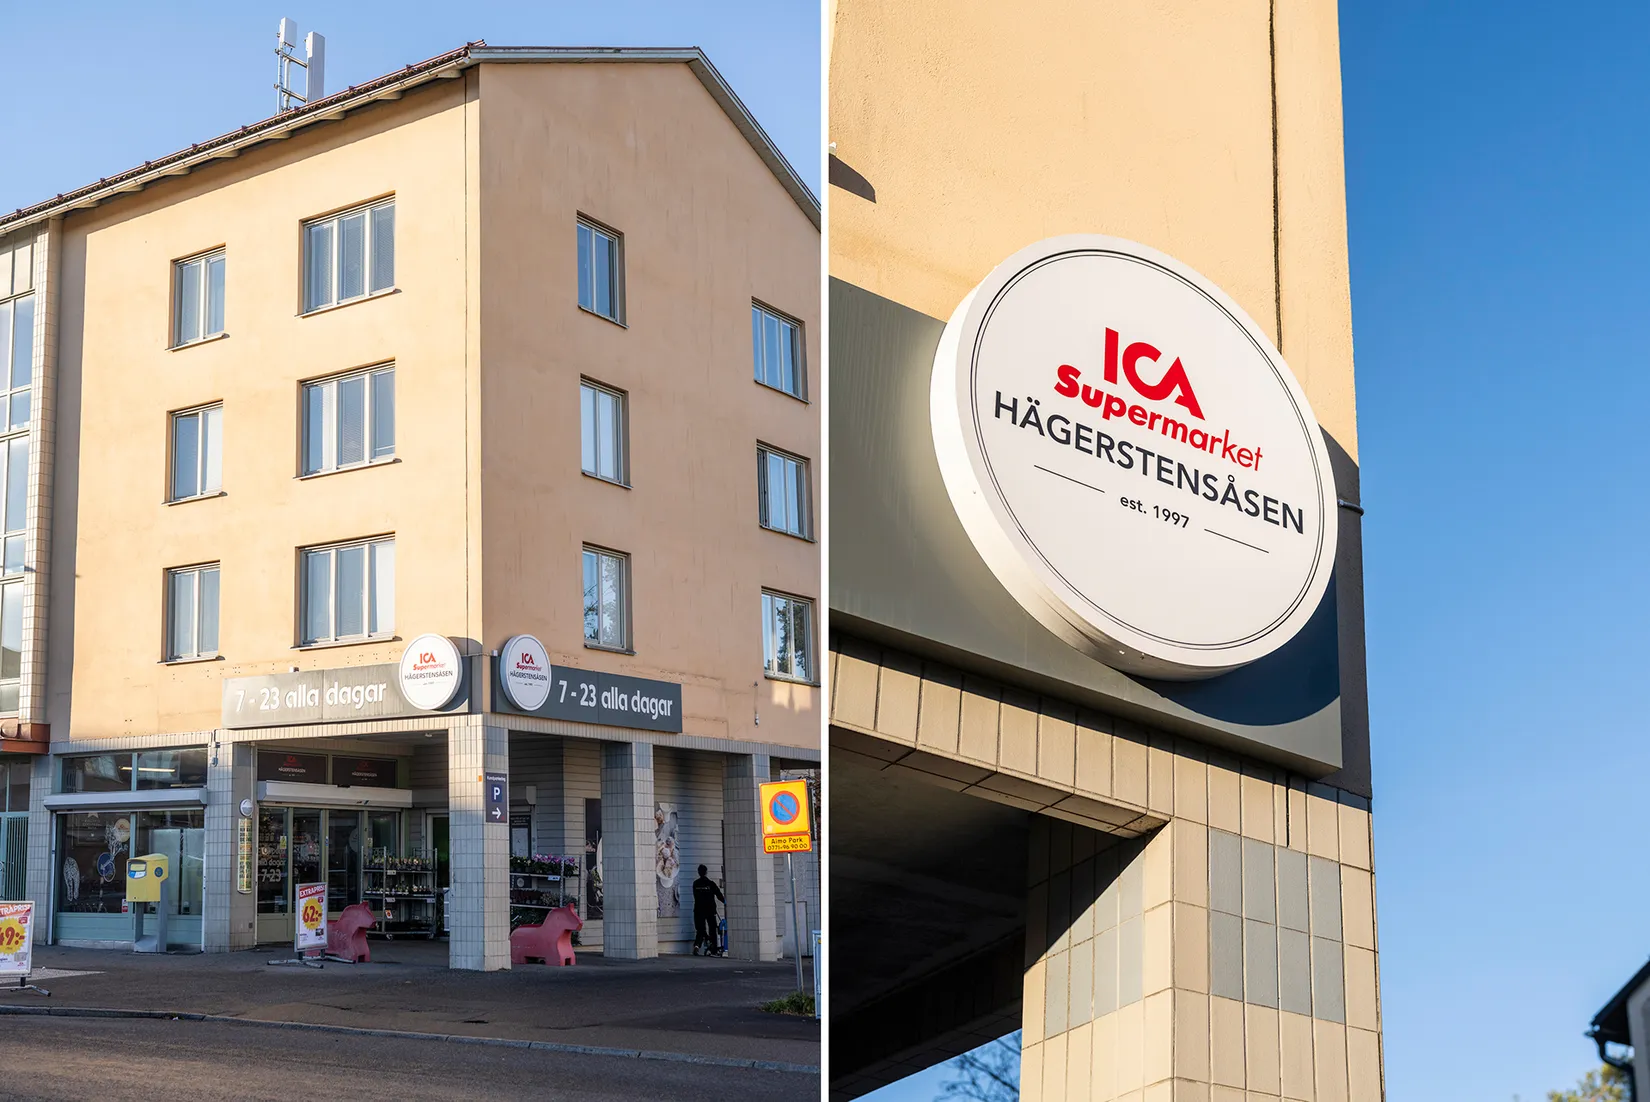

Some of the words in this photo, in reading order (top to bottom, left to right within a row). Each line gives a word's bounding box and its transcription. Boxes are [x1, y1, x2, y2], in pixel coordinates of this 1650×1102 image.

[1104, 327, 1205, 420] ICA
[1054, 364, 1263, 471] Supermarket
[994, 390, 1304, 535] HÄGERSTENSÅSEN
[1120, 496, 1147, 514] est.
[1153, 505, 1190, 528] 1997
[413, 663, 446, 671] Supermarket
[420, 652, 436, 664] ICA
[516, 662, 542, 672] Supermarket
[522, 653, 535, 665] ICA
[405, 671, 453, 680] HÄGERSTENSÅSEN
[236, 690, 247, 713] 7
[259, 686, 280, 711] 23
[285, 684, 320, 709] alla
[326, 681, 387, 710] dagar
[559, 680, 568, 703] 7
[580, 683, 597, 708] 23
[601, 687, 628, 711] alla
[631, 690, 673, 720] dagar
[493, 787, 501, 800] P
